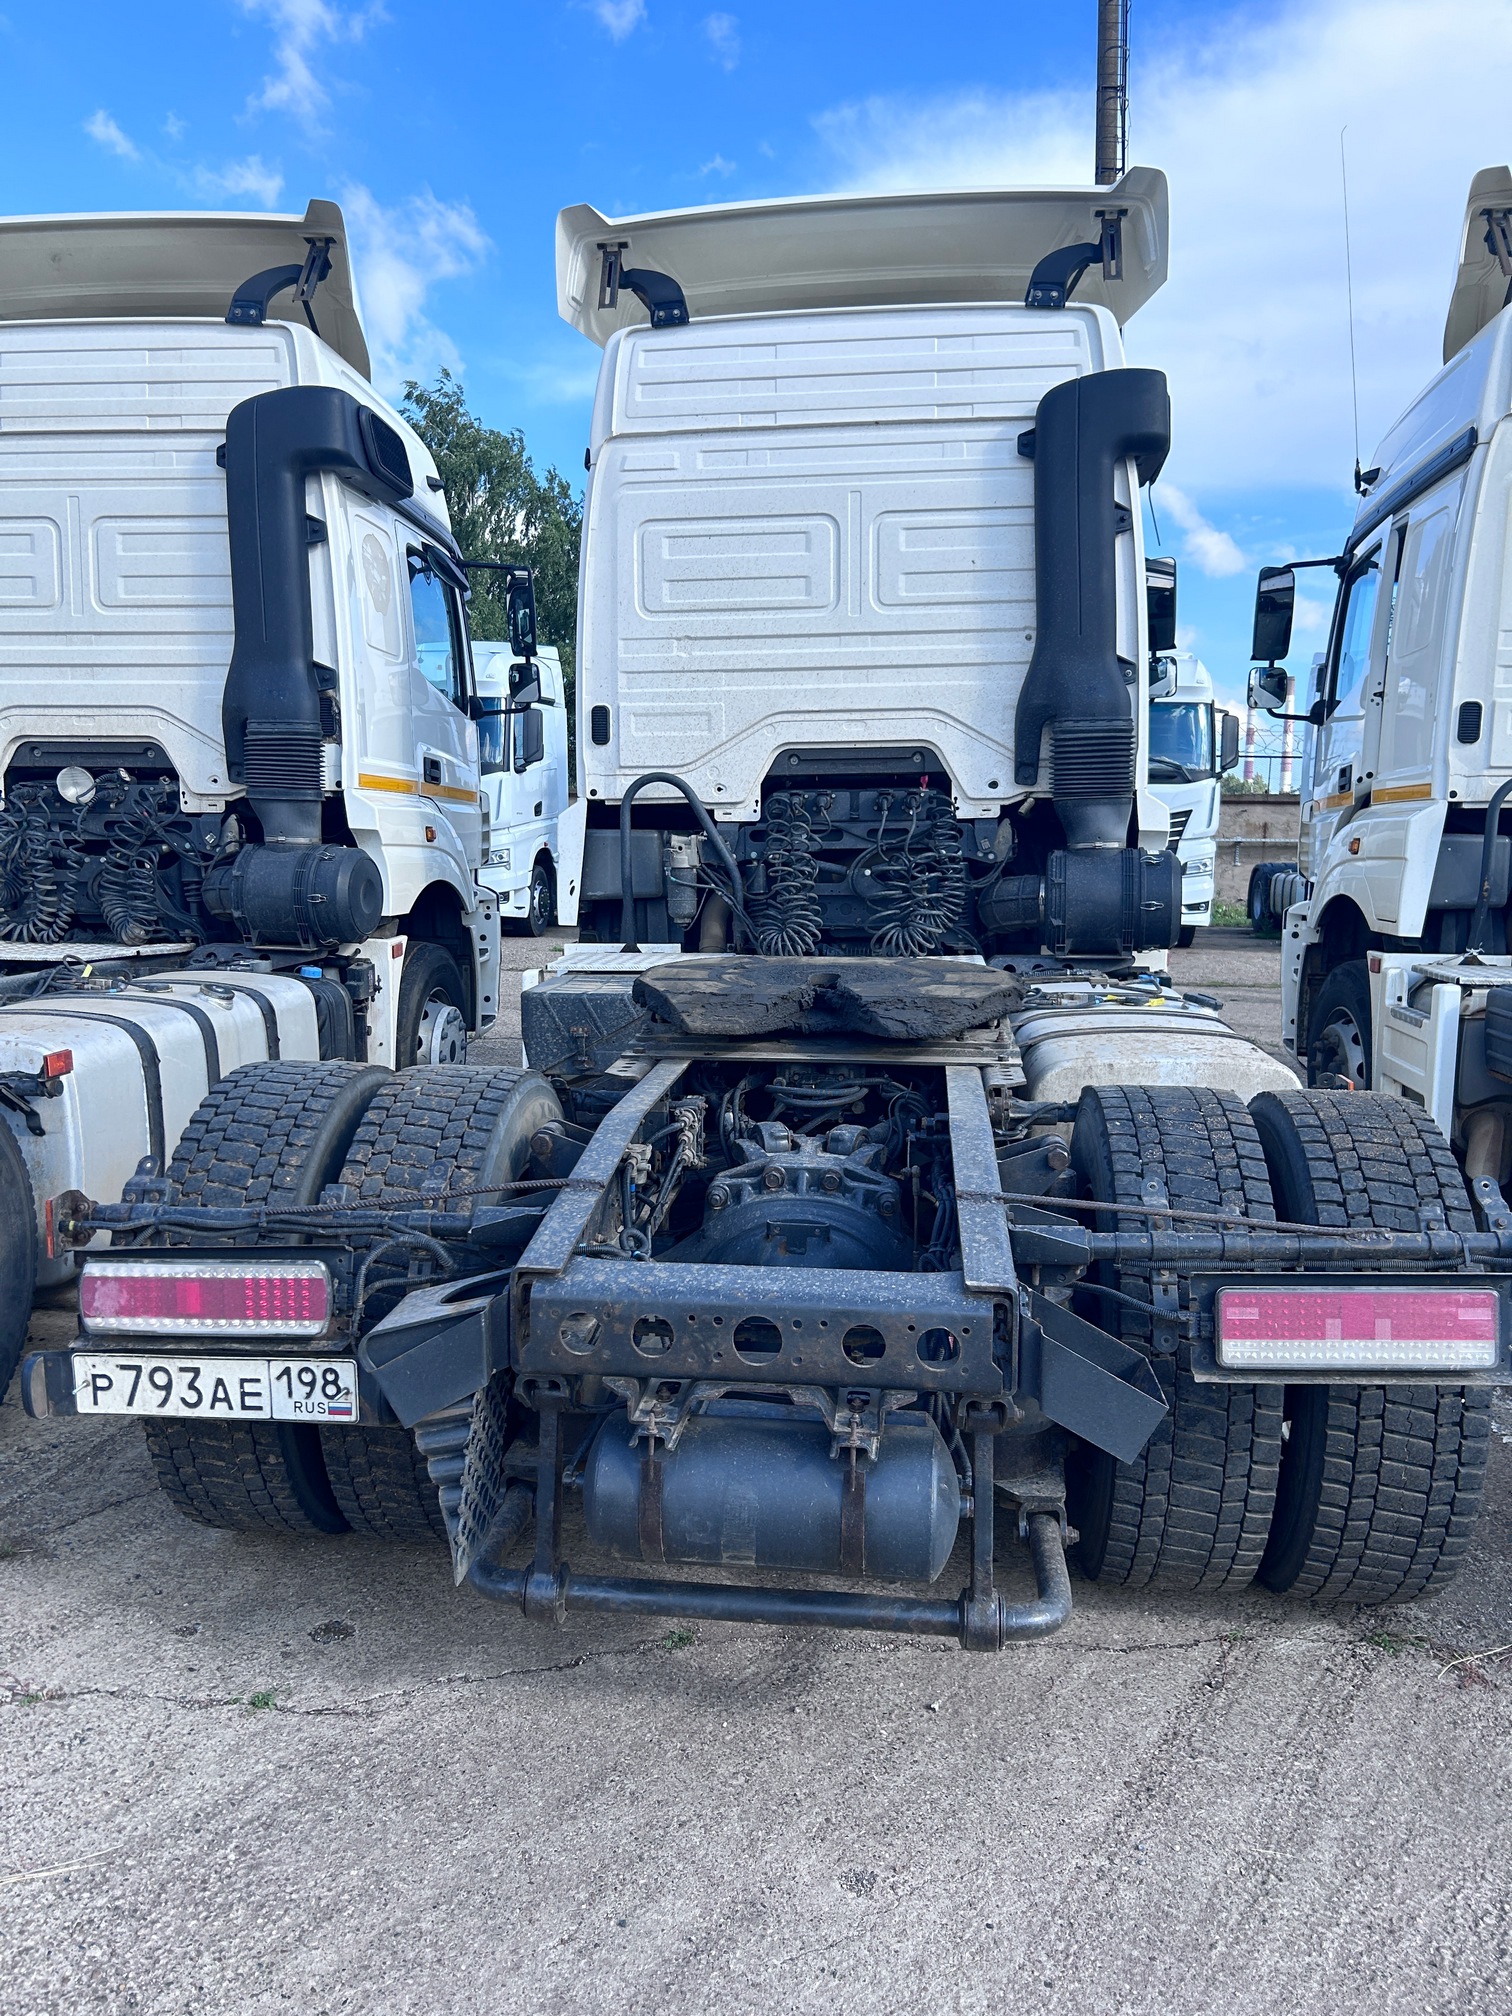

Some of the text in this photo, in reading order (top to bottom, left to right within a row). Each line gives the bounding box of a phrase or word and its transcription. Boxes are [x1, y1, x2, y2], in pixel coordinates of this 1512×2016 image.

[91, 1363, 341, 1411] P793AE 198
[293, 1401, 327, 1415] RUS
